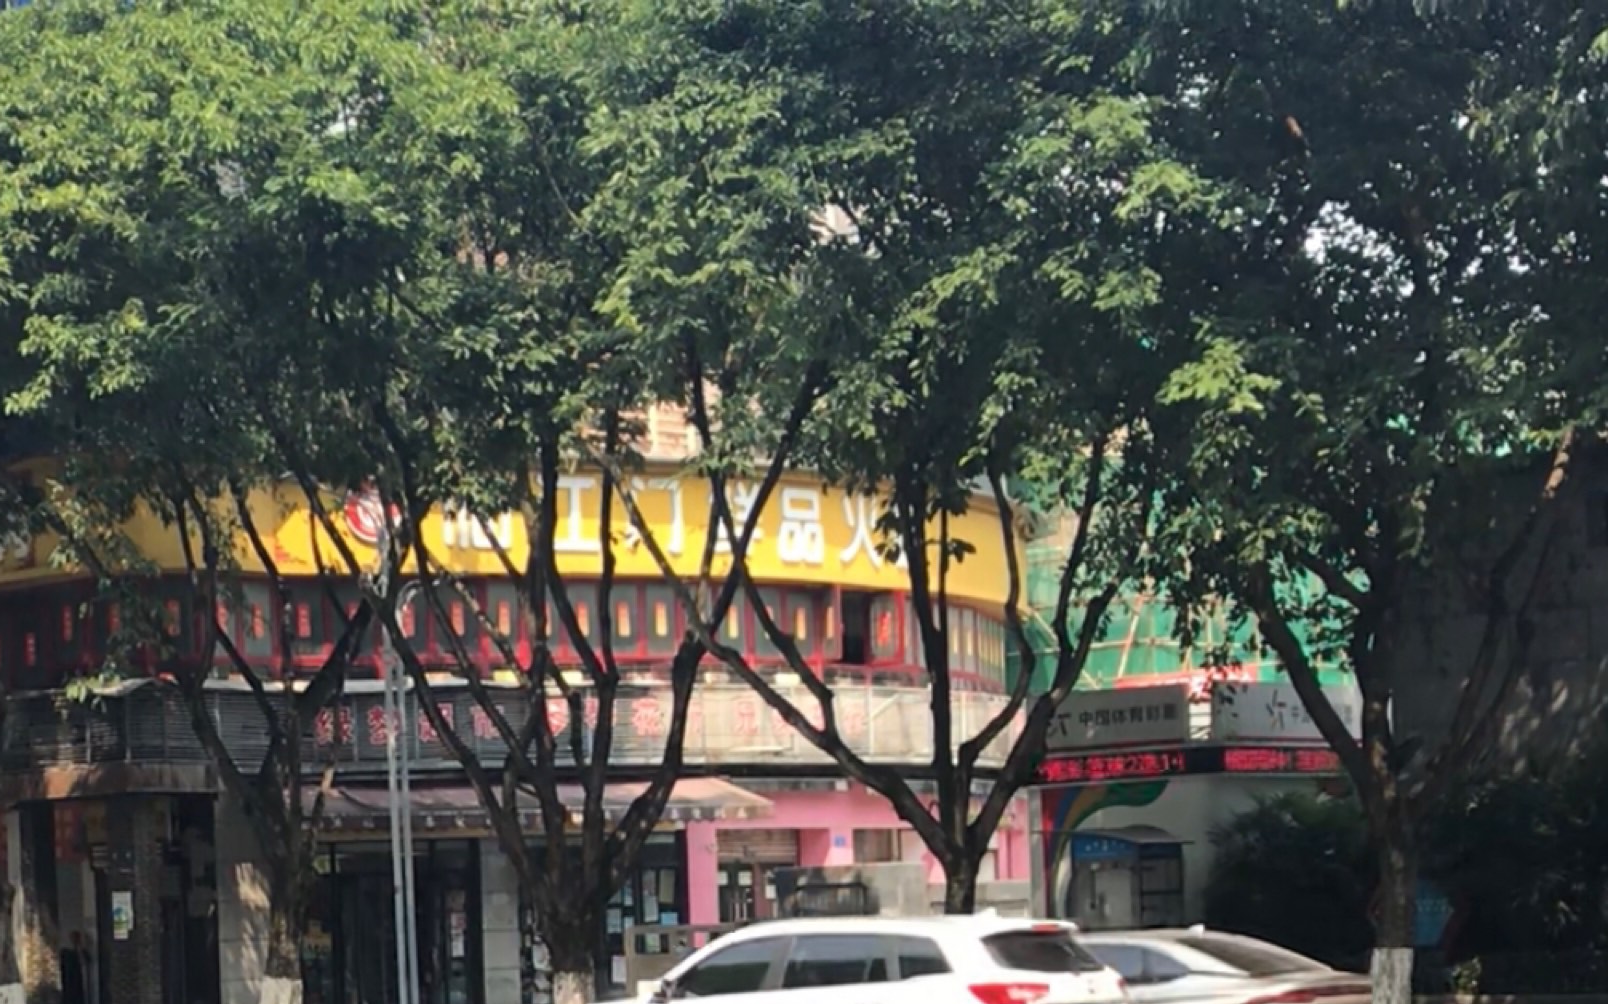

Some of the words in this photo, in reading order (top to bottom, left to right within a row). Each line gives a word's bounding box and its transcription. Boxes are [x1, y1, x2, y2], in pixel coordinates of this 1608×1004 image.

[443, 474, 914, 569] 临江门鲜品火
